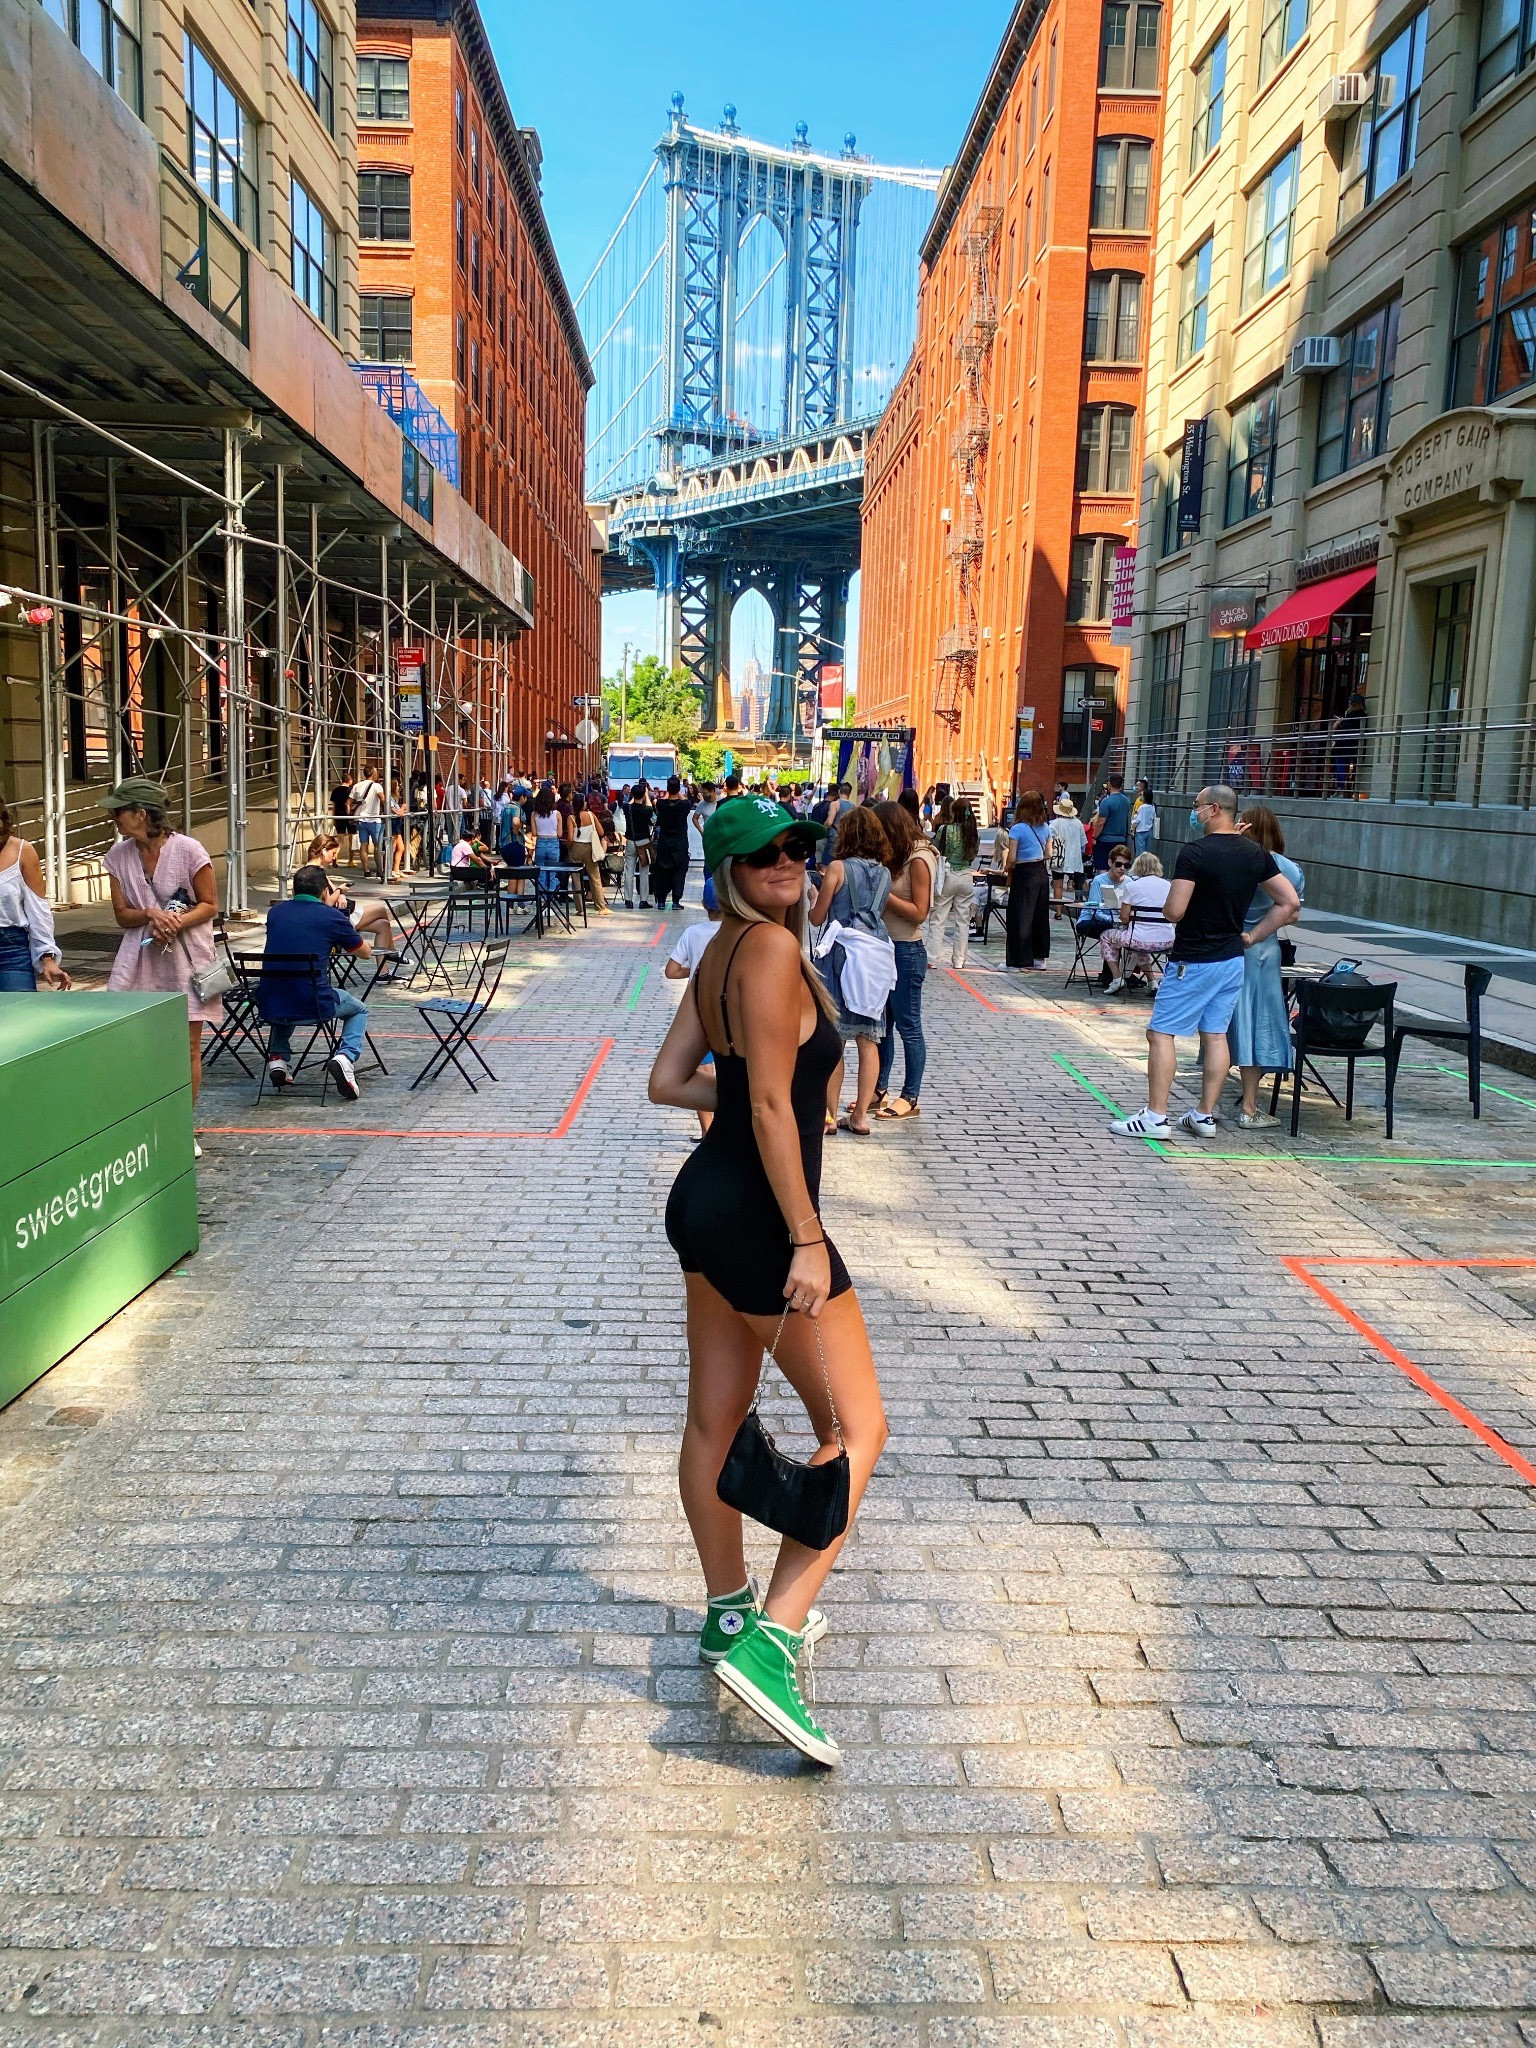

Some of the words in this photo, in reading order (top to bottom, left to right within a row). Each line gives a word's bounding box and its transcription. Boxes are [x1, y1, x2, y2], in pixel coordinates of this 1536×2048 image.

[1186, 424, 1195, 434] 55
[1182, 435, 1195, 484] Washington
[1396, 428, 1452, 487] ROBERT
[1456, 425, 1490, 453] GAIR
[1182, 485, 1191, 496] St.
[1404, 463, 1474, 508] COMPANY
[1294, 553, 1329, 580] SALON
[1333, 534, 1380, 572] DUMBO
[1220, 606, 1245, 618] SALON
[1220, 613, 1248, 625] DUMBO
[1261, 629, 1282, 647] SALON
[1282, 622, 1309, 642] DUMBO
[401, 694, 407, 702] 2
[15, 1142, 149, 1249] sweetgreen
